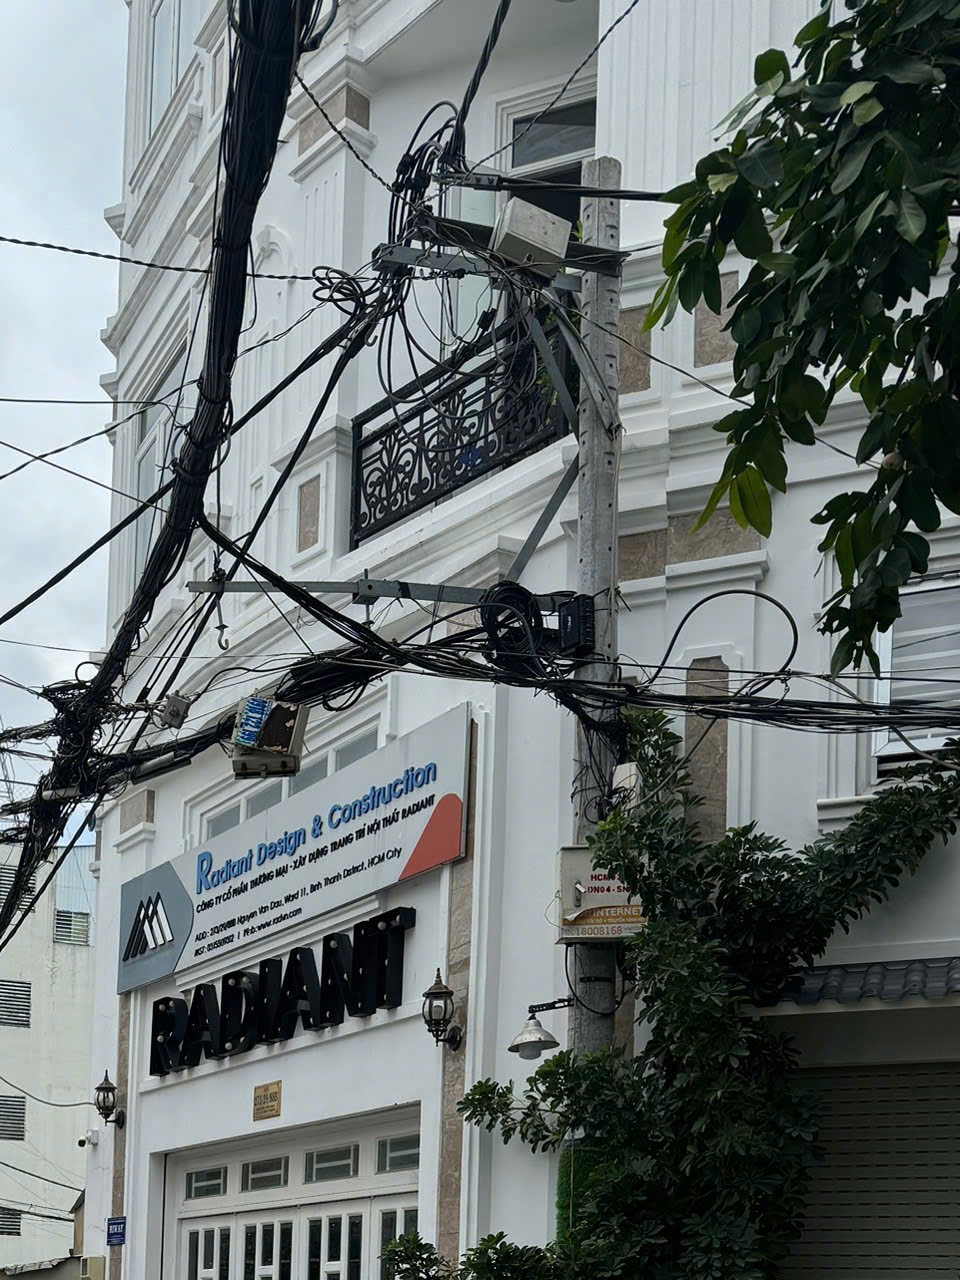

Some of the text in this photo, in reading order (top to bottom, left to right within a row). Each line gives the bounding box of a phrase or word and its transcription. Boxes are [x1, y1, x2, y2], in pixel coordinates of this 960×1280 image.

[196, 762, 437, 895] Radiant Design & Construction
[400, 793, 436, 820] RADIANT
[575, 927, 623, 936] 18008168
[149, 905, 417, 1078] RADIANT
